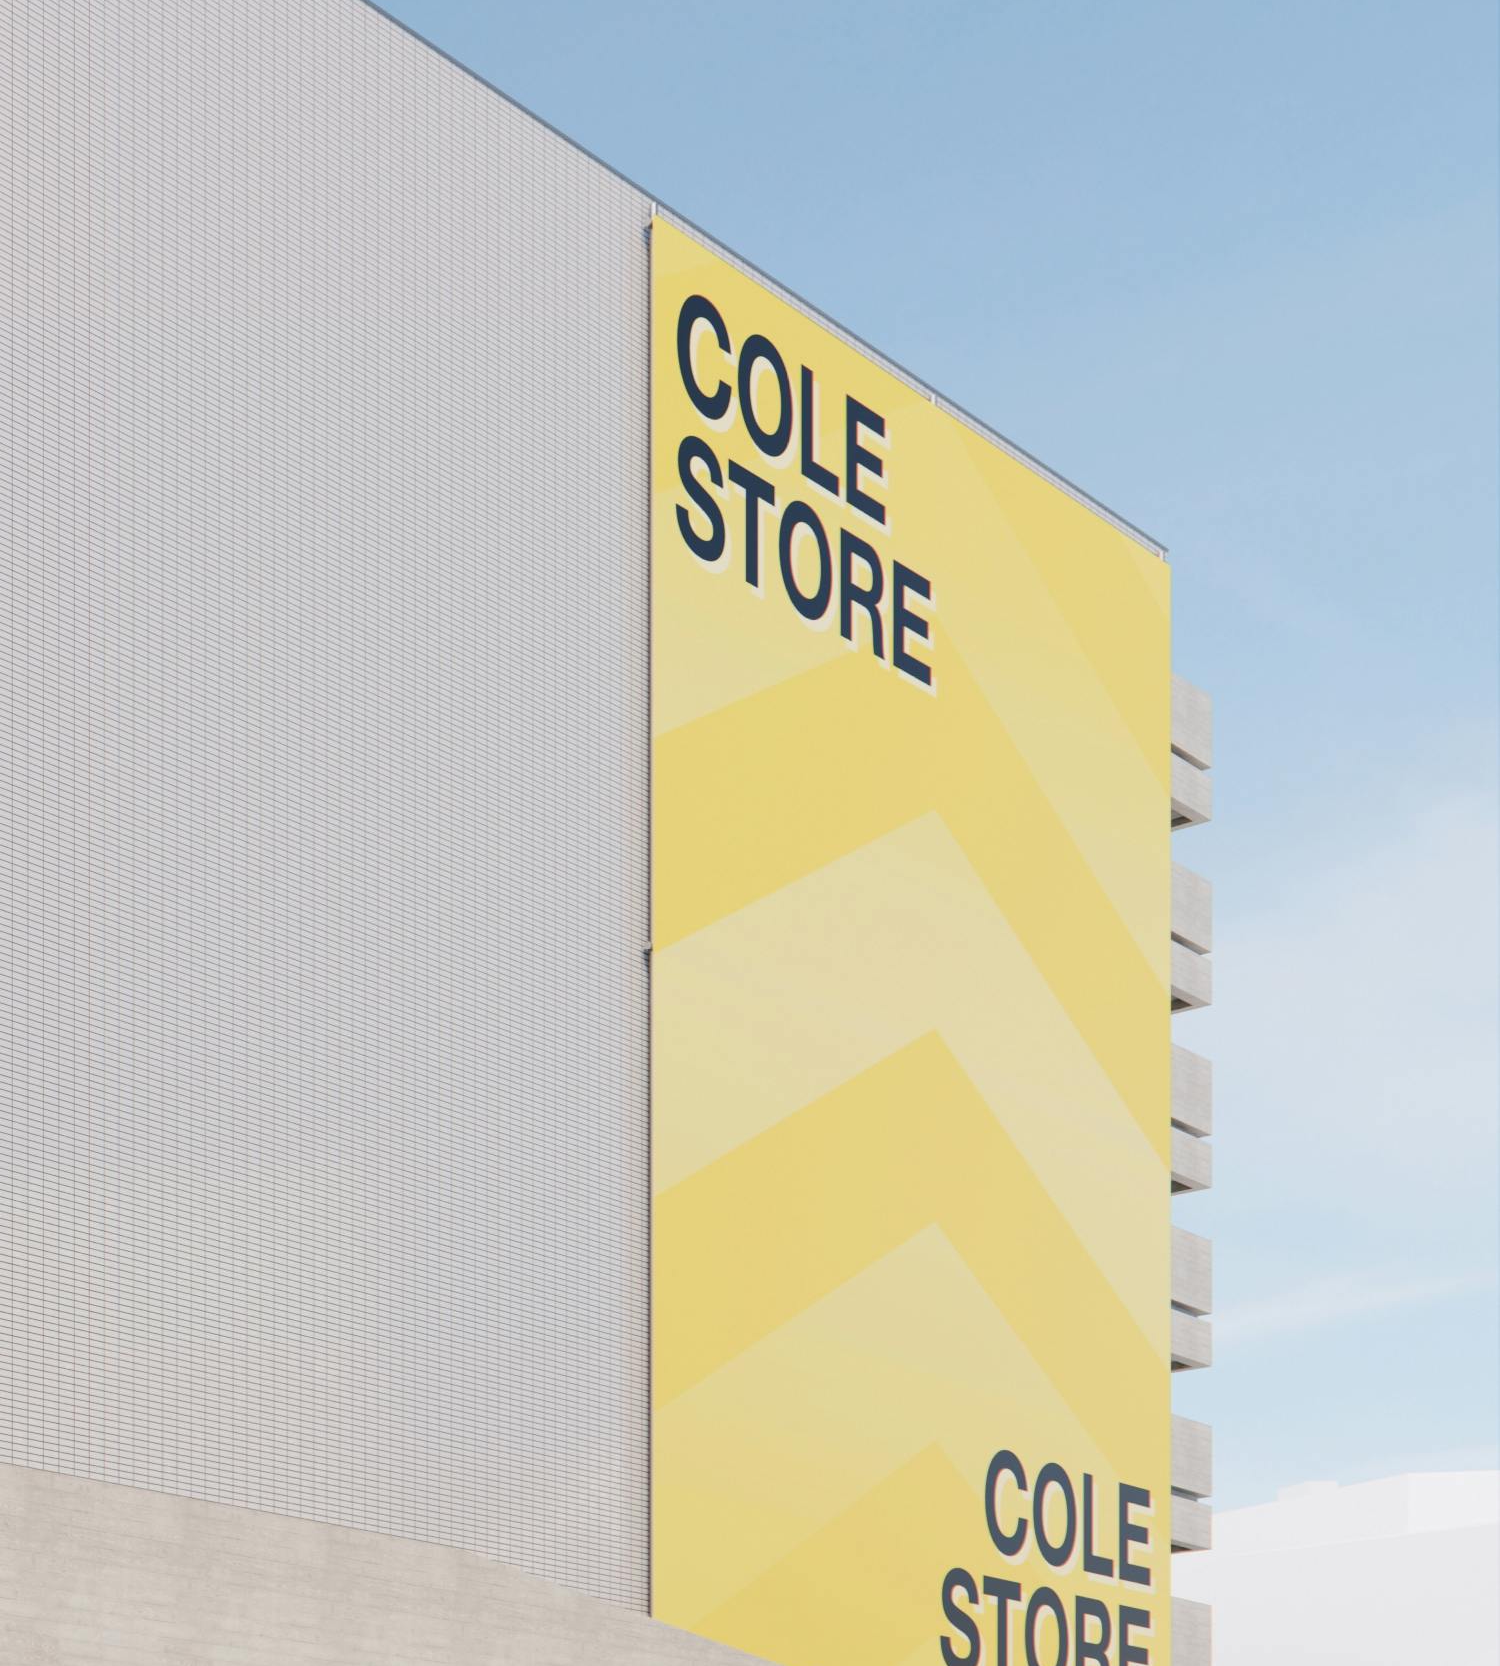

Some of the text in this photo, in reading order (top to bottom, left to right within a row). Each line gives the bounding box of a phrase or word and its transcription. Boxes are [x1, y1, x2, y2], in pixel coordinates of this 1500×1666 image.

[675, 294, 886, 525] COLE
[675, 435, 932, 686] STORE
[984, 1449, 1151, 1586] COLE
